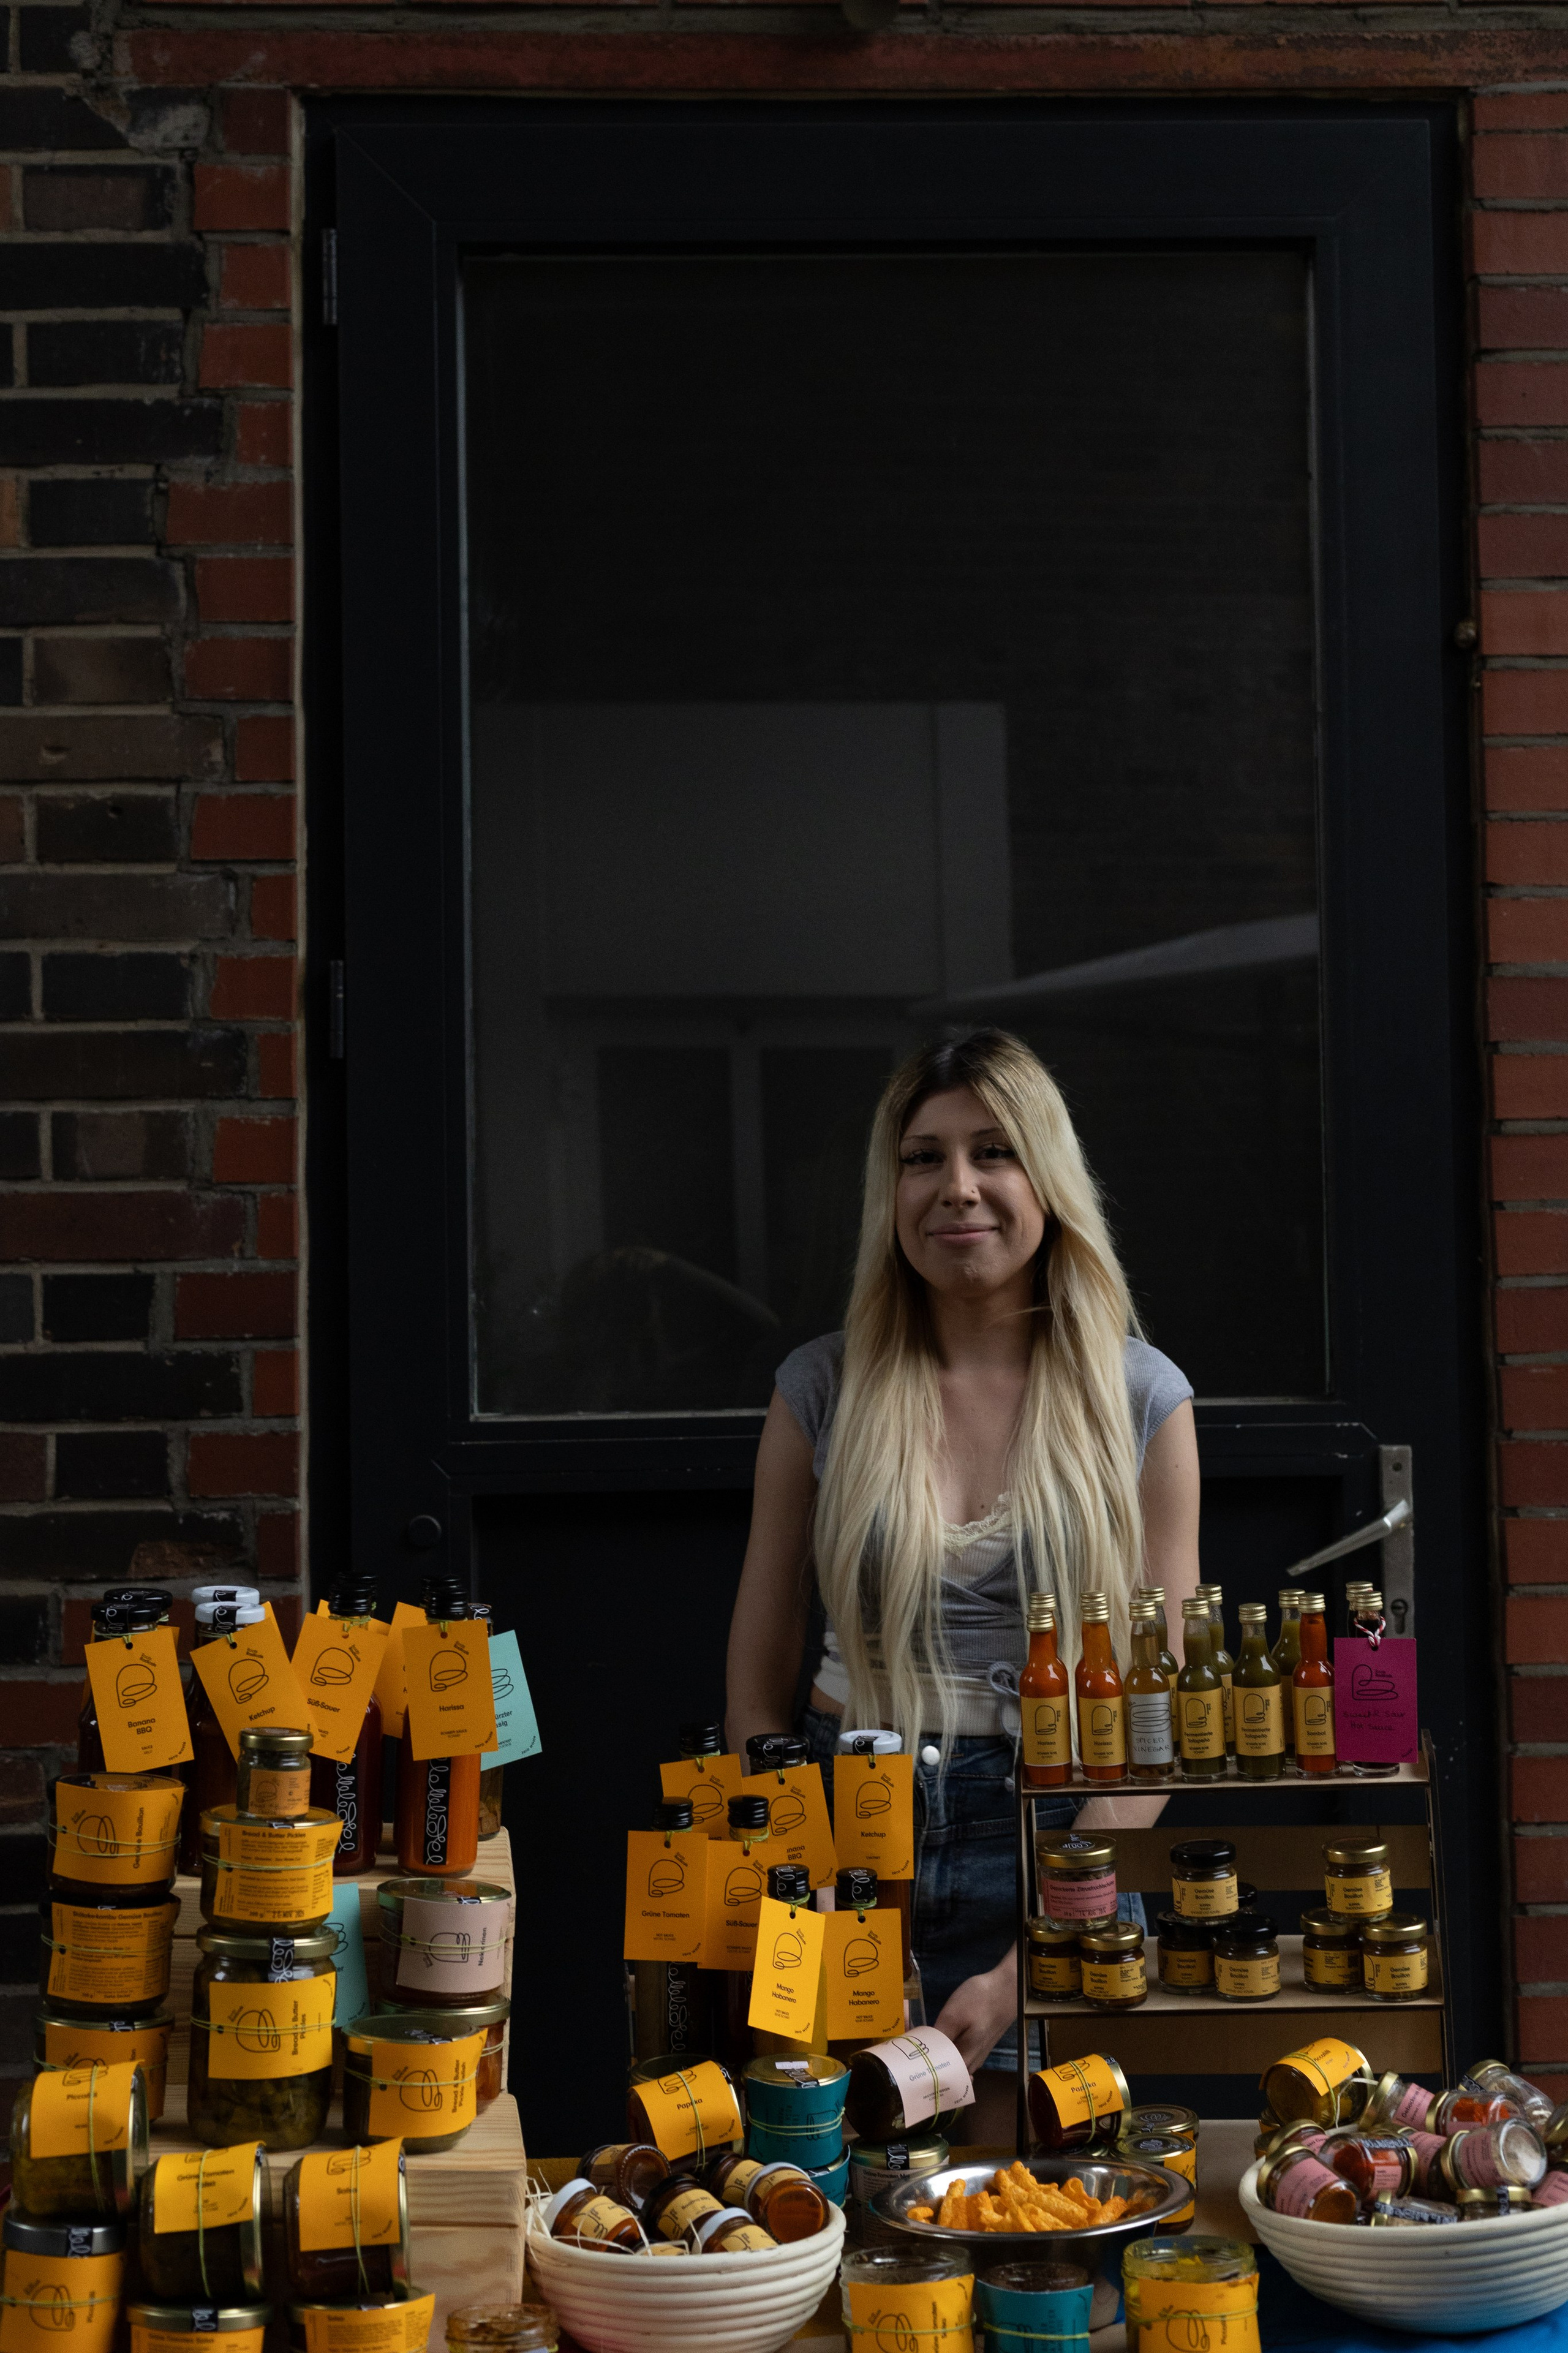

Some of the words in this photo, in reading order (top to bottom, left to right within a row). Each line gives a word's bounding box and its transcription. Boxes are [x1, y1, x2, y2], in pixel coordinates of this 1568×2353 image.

[307, 1698, 341, 1713] Süß-Sauer
[249, 1706, 276, 1721] Ketchup
[495, 1710, 513, 1721] ürzter
[128, 1718, 156, 1728] Banana
[137, 1726, 153, 1735] BBQ
[776, 1983, 794, 1994] Mango
[772, 1991, 797, 2003] Habanero
[909, 2070, 927, 2081] Grüne
